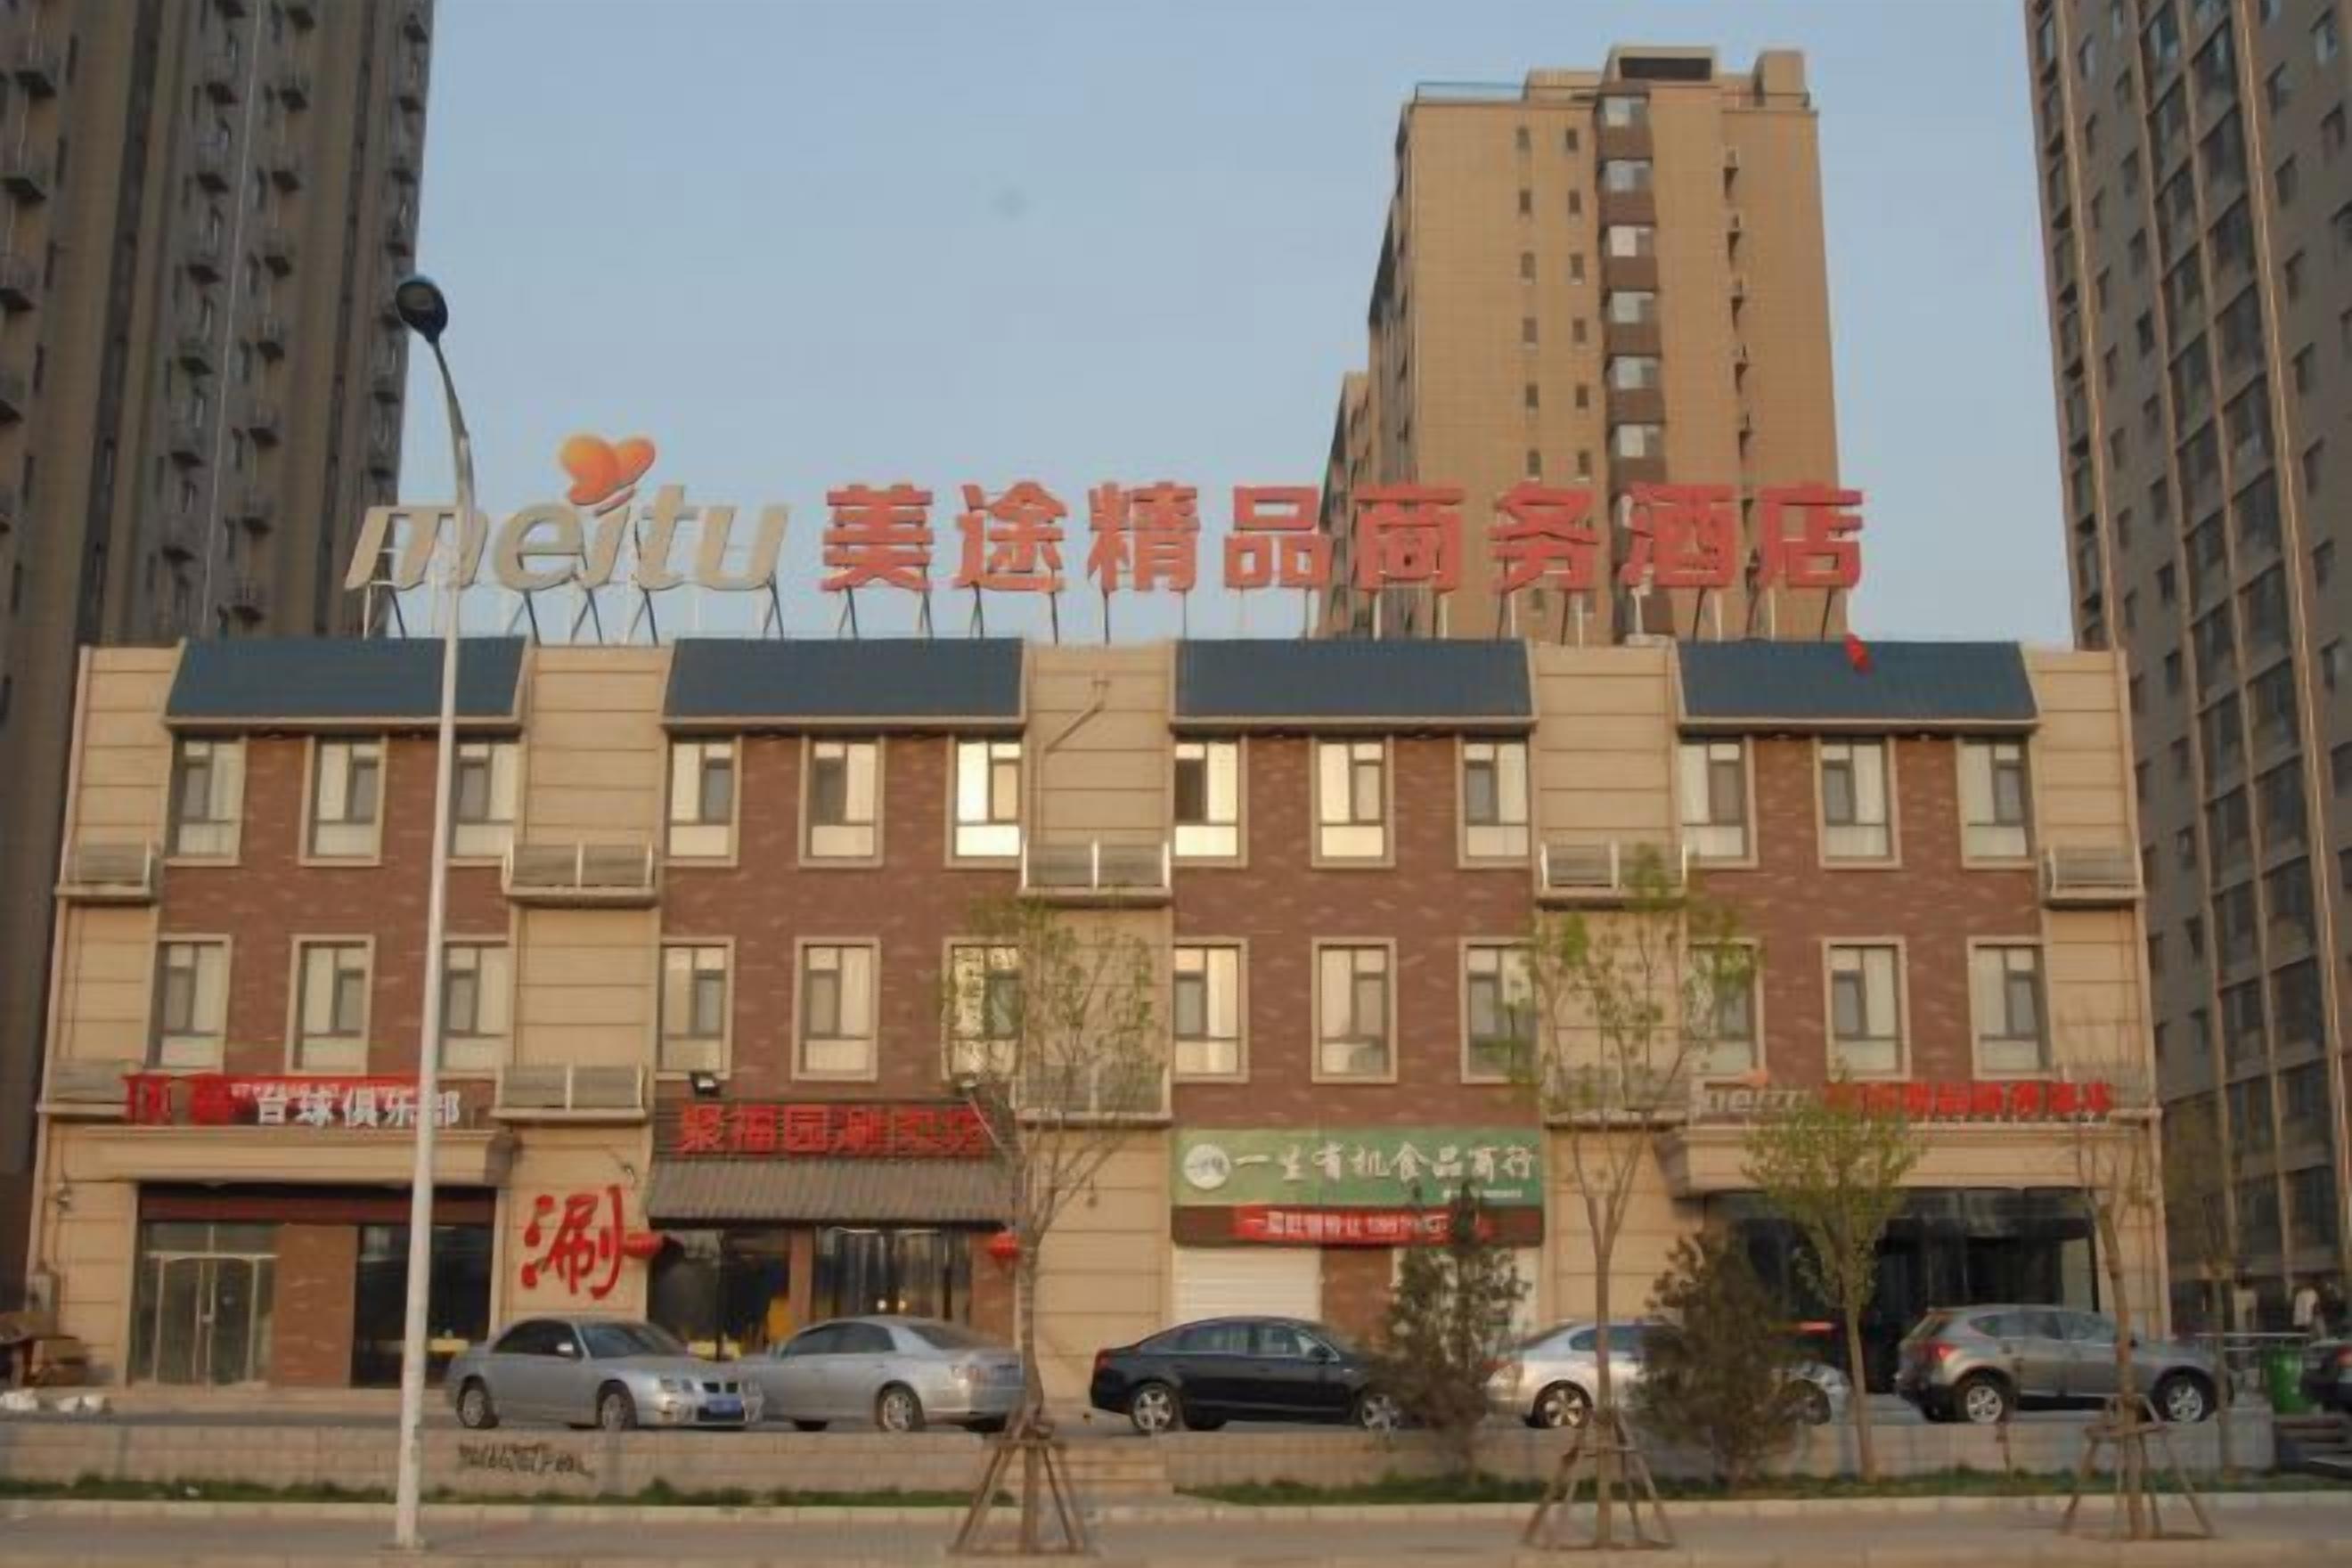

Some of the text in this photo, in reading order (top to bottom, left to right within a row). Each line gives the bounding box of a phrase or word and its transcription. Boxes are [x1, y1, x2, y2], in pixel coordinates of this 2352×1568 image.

[345, 484, 788, 591] meitu
[820, 482, 1863, 592] 美途精品商务酒店
[521, 1184, 625, 1301] 涮
